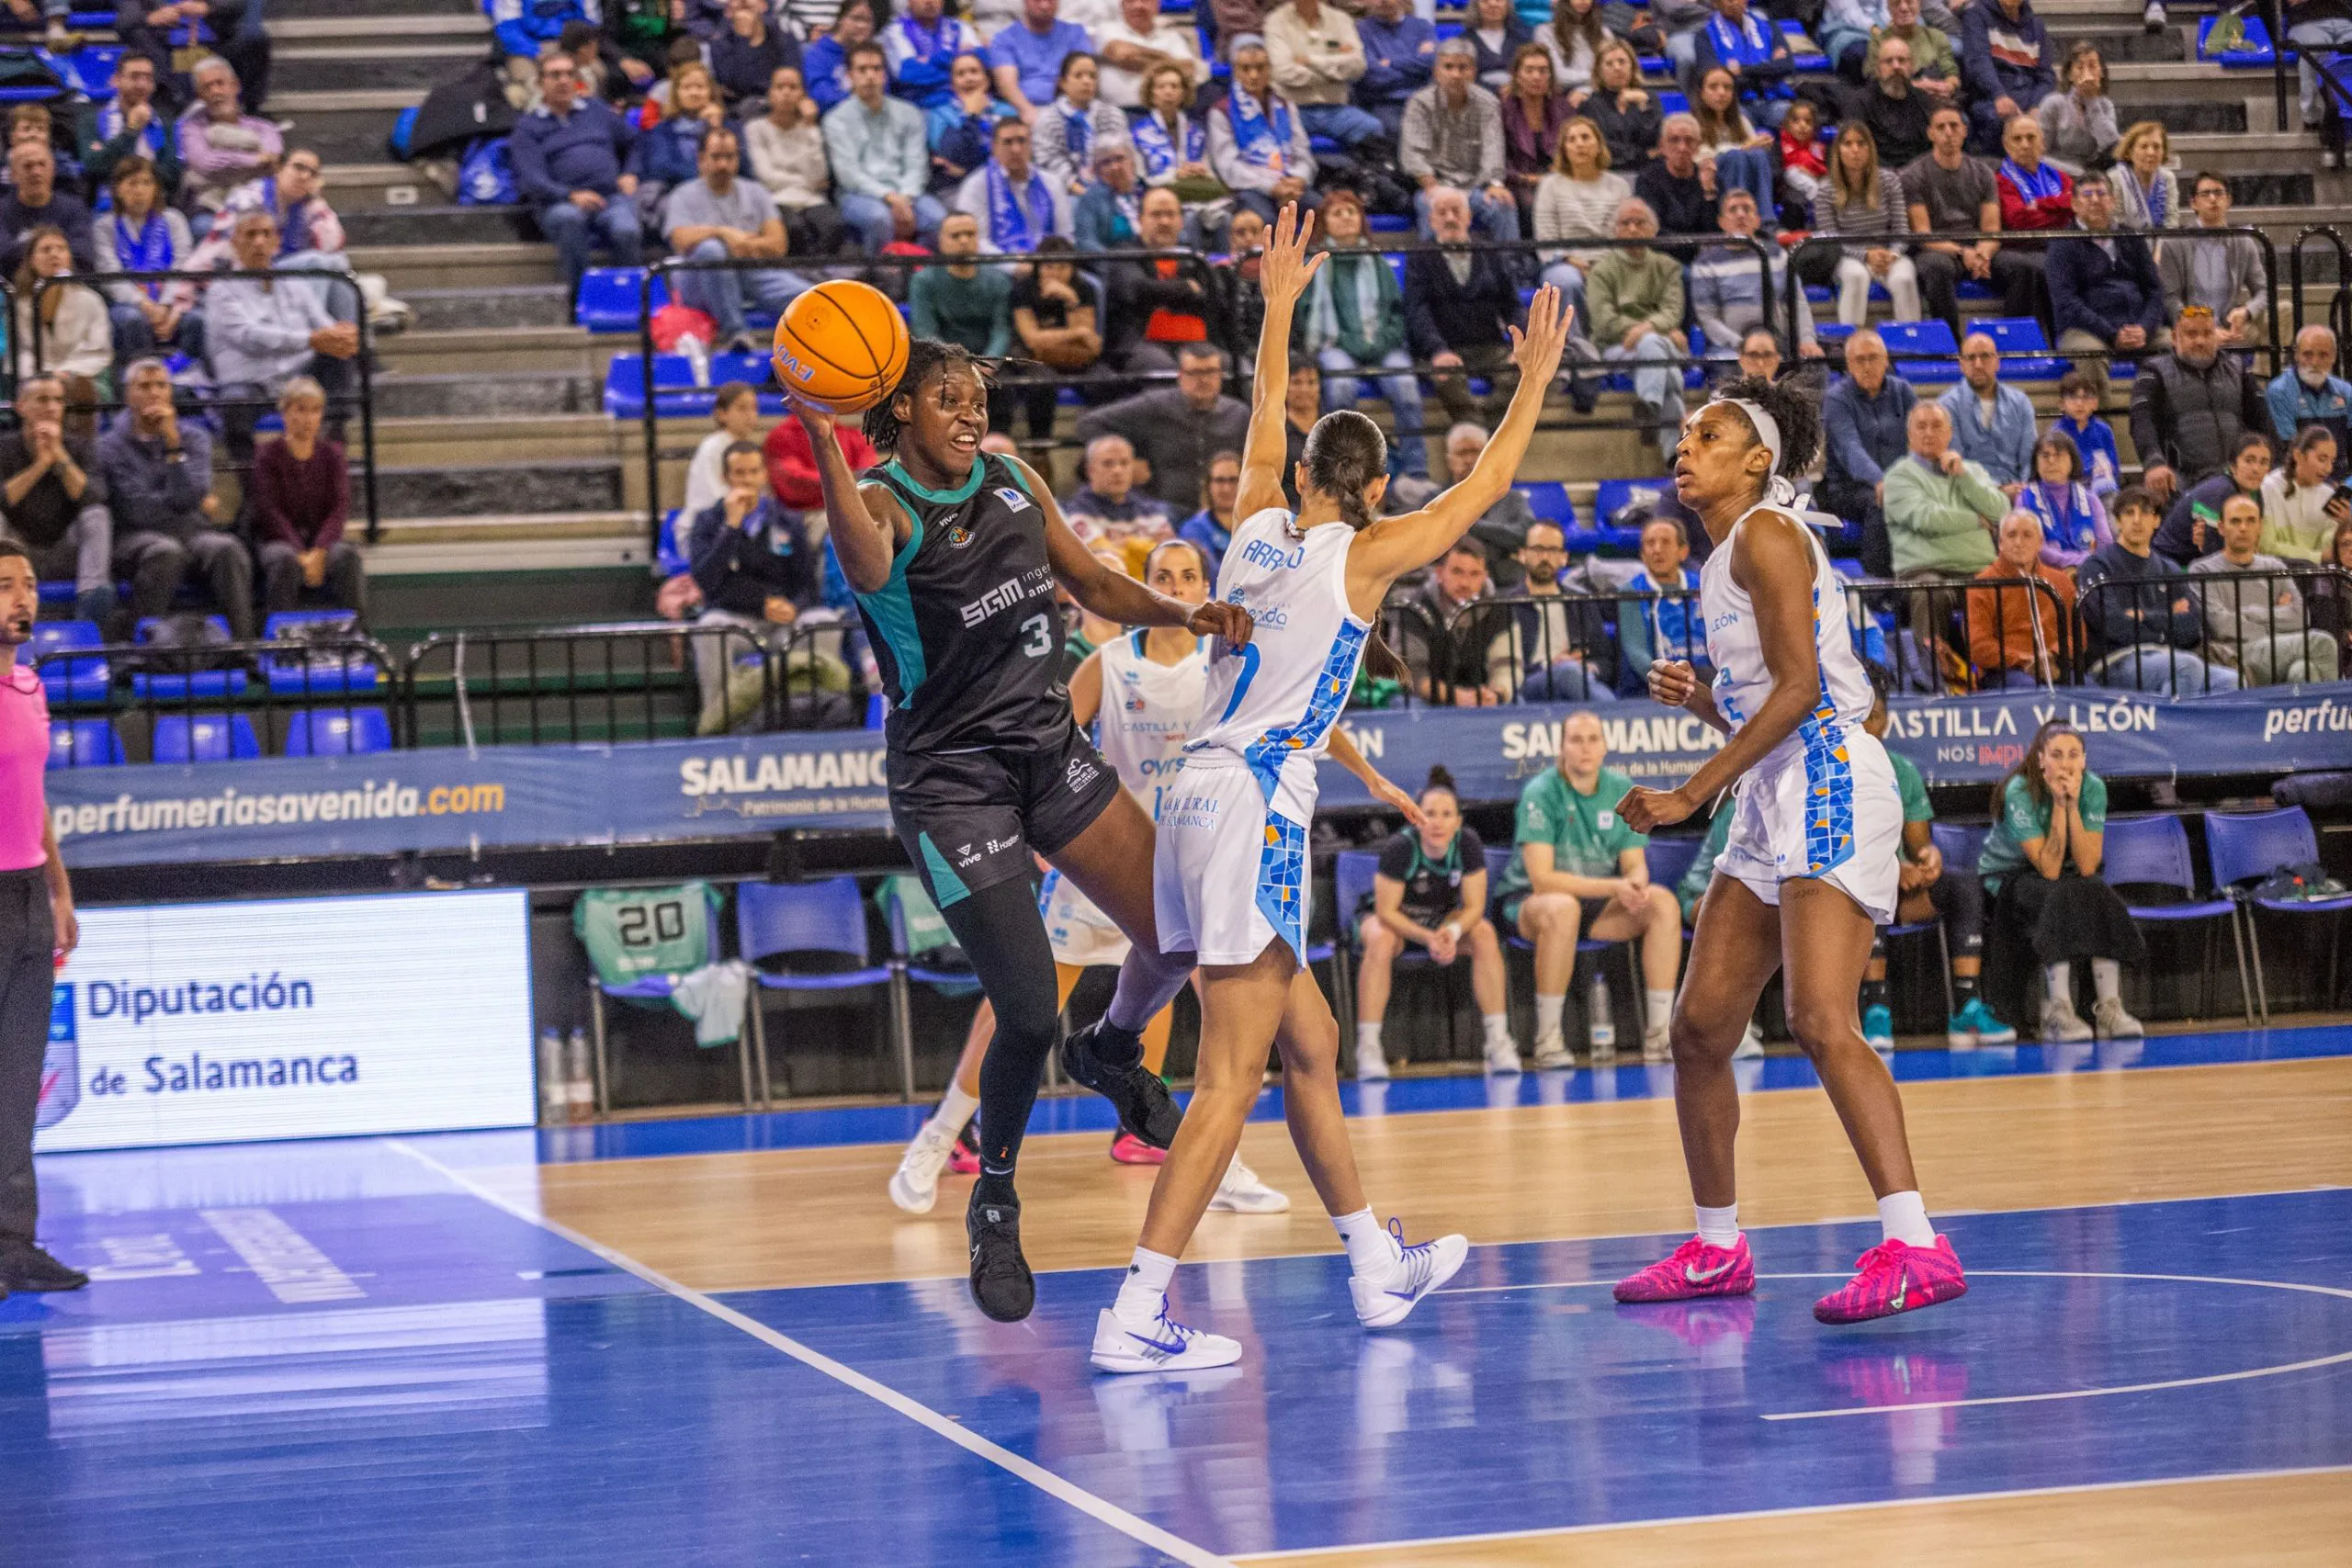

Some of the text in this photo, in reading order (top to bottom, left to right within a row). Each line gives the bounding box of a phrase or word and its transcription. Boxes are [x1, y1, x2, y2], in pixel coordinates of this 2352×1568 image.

[960, 578, 1024, 629] SGM
[1021, 613, 1052, 658] 3
[1883, 706, 2018, 739] ASTILLA
[2069, 695, 2156, 732] LEÓN
[2264, 698, 2352, 742] perfu
[680, 751, 888, 795] SALAMANC
[1938, 745, 1974, 763] NOS
[51, 781, 504, 845] perfumeriasavenida.com
[958, 853, 982, 868] vive
[617, 900, 684, 947] 20
[87, 973, 314, 1023] Diputación
[91, 1052, 359, 1097] de Salamanca
